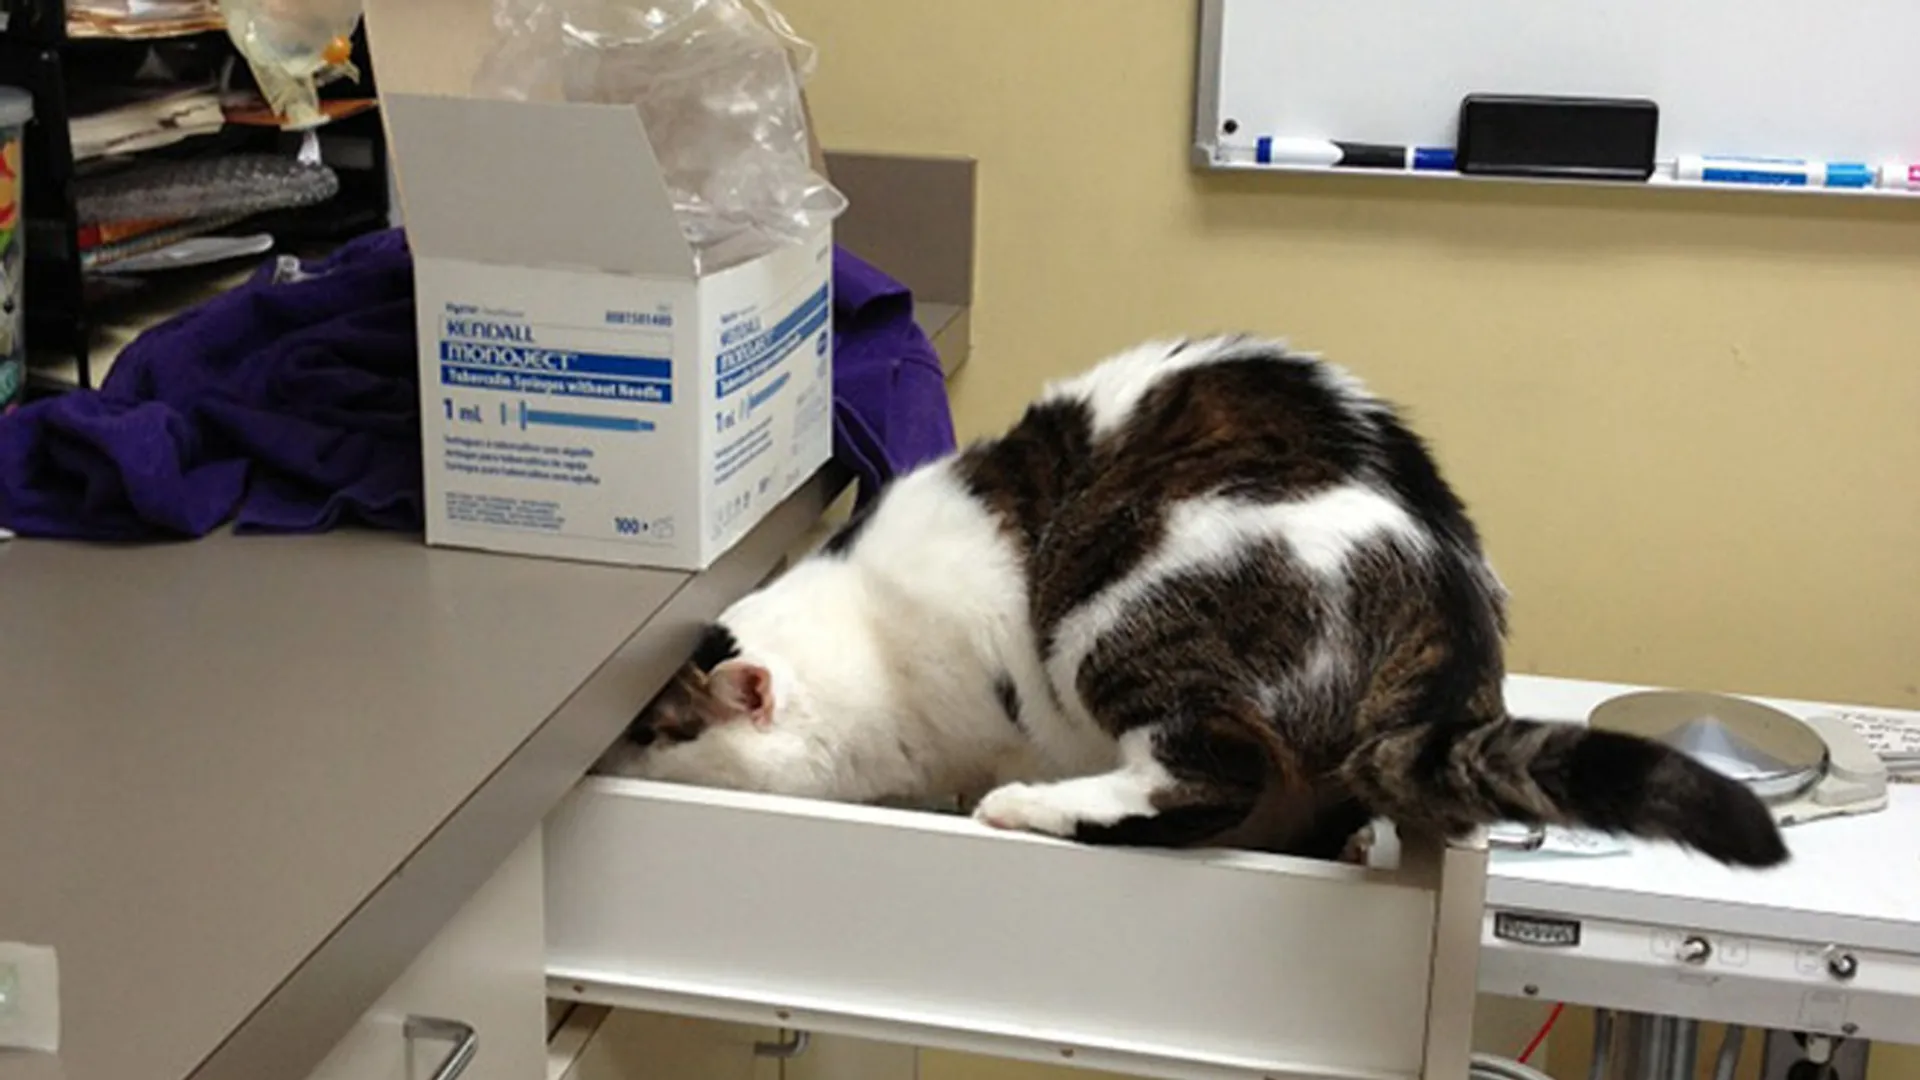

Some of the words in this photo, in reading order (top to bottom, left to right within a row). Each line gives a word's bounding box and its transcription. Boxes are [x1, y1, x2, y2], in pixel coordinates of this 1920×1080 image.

[447, 320, 536, 343] KENDALL
[513, 373, 564, 395] Syringes
[567, 379, 616, 397] without
[618, 382, 663, 400] Needle
[443, 397, 454, 420] 1
[614, 516, 640, 535] 100
